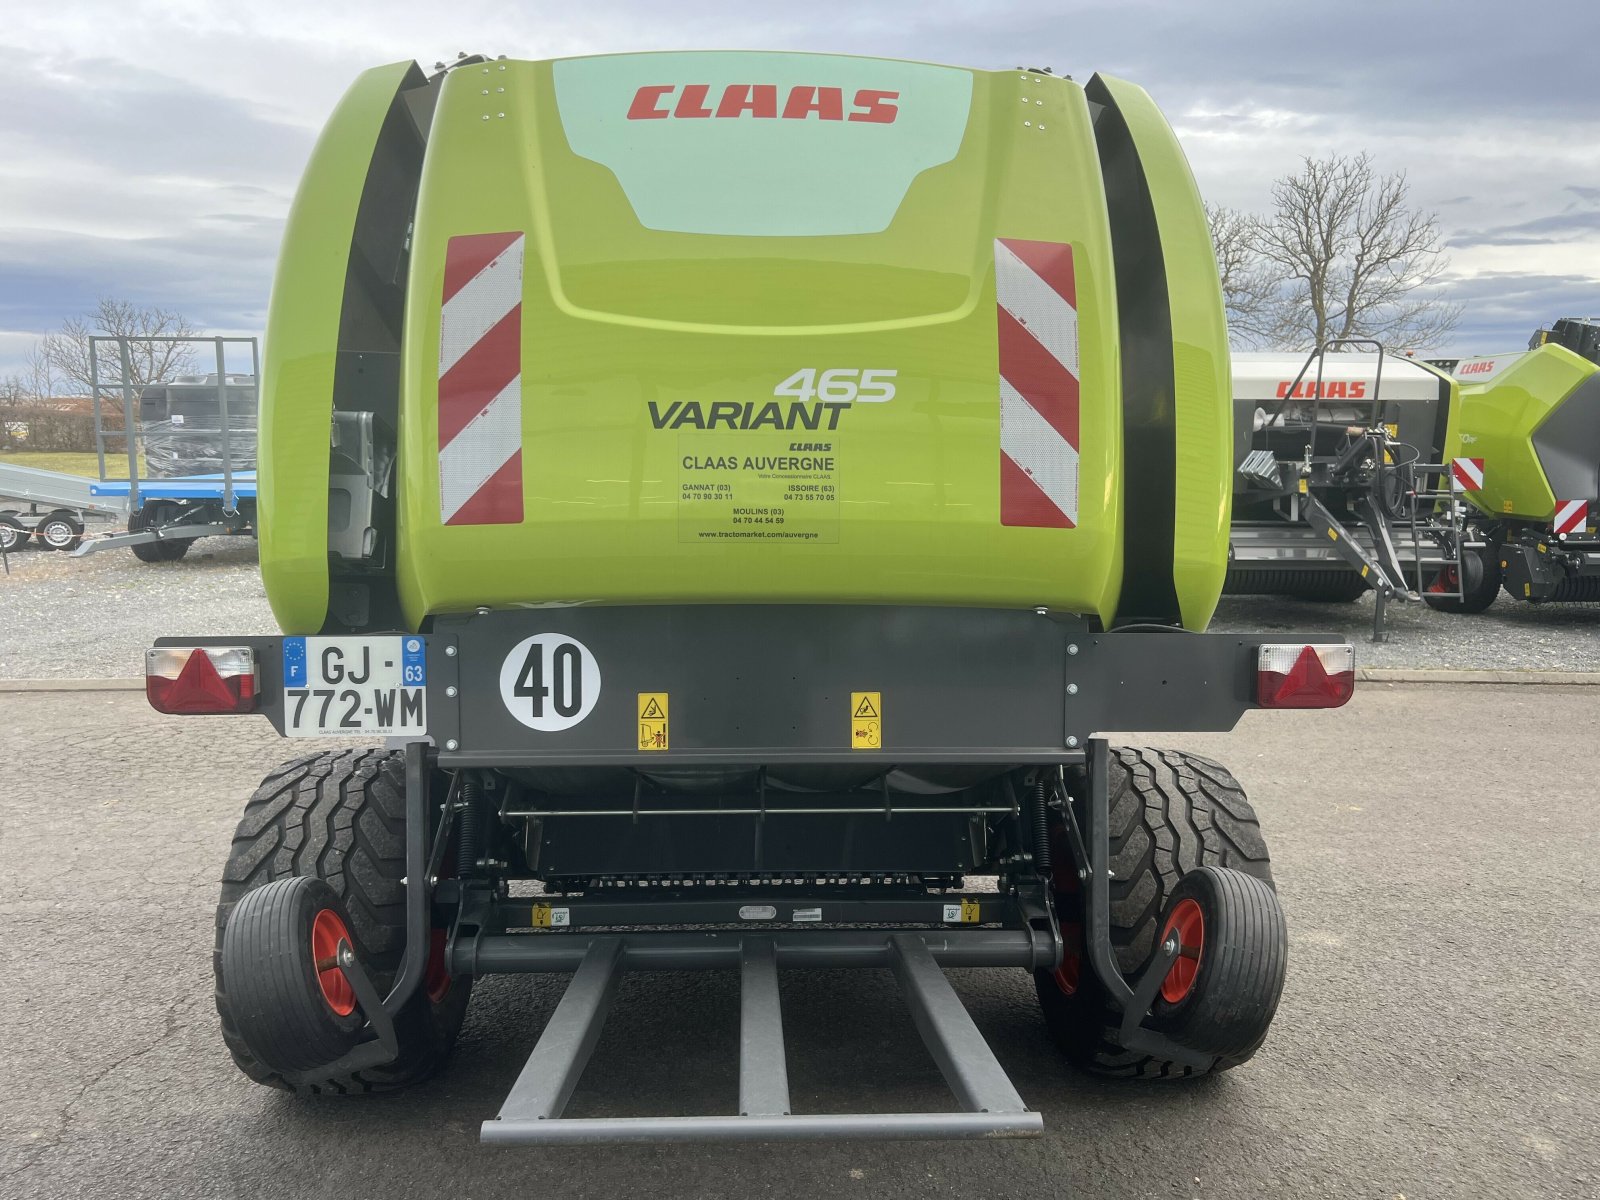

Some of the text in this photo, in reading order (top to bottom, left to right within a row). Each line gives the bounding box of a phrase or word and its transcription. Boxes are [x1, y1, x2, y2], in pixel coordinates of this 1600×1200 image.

[626, 84, 900, 124] CLAAS
[1459, 361, 1495, 375] CLAAS
[773, 368, 898, 403] 465
[1276, 381, 1366, 398] CLAAS
[647, 401, 852, 430] VARIANT
[789, 443, 832, 452] CLAAS
[682, 456, 835, 471] CLAAS AUVERGNE
[717, 484, 731, 493] (03)
[788, 484, 835, 493] ISSOIRE (63)
[770, 508, 785, 516] (03)
[698, 531, 818, 540] www.tractomarket.com/auvergne
[290, 665, 299, 677] F
[405, 665, 423, 682] 63
[513, 643, 582, 718] 40
[287, 688, 424, 729] 772-WM
